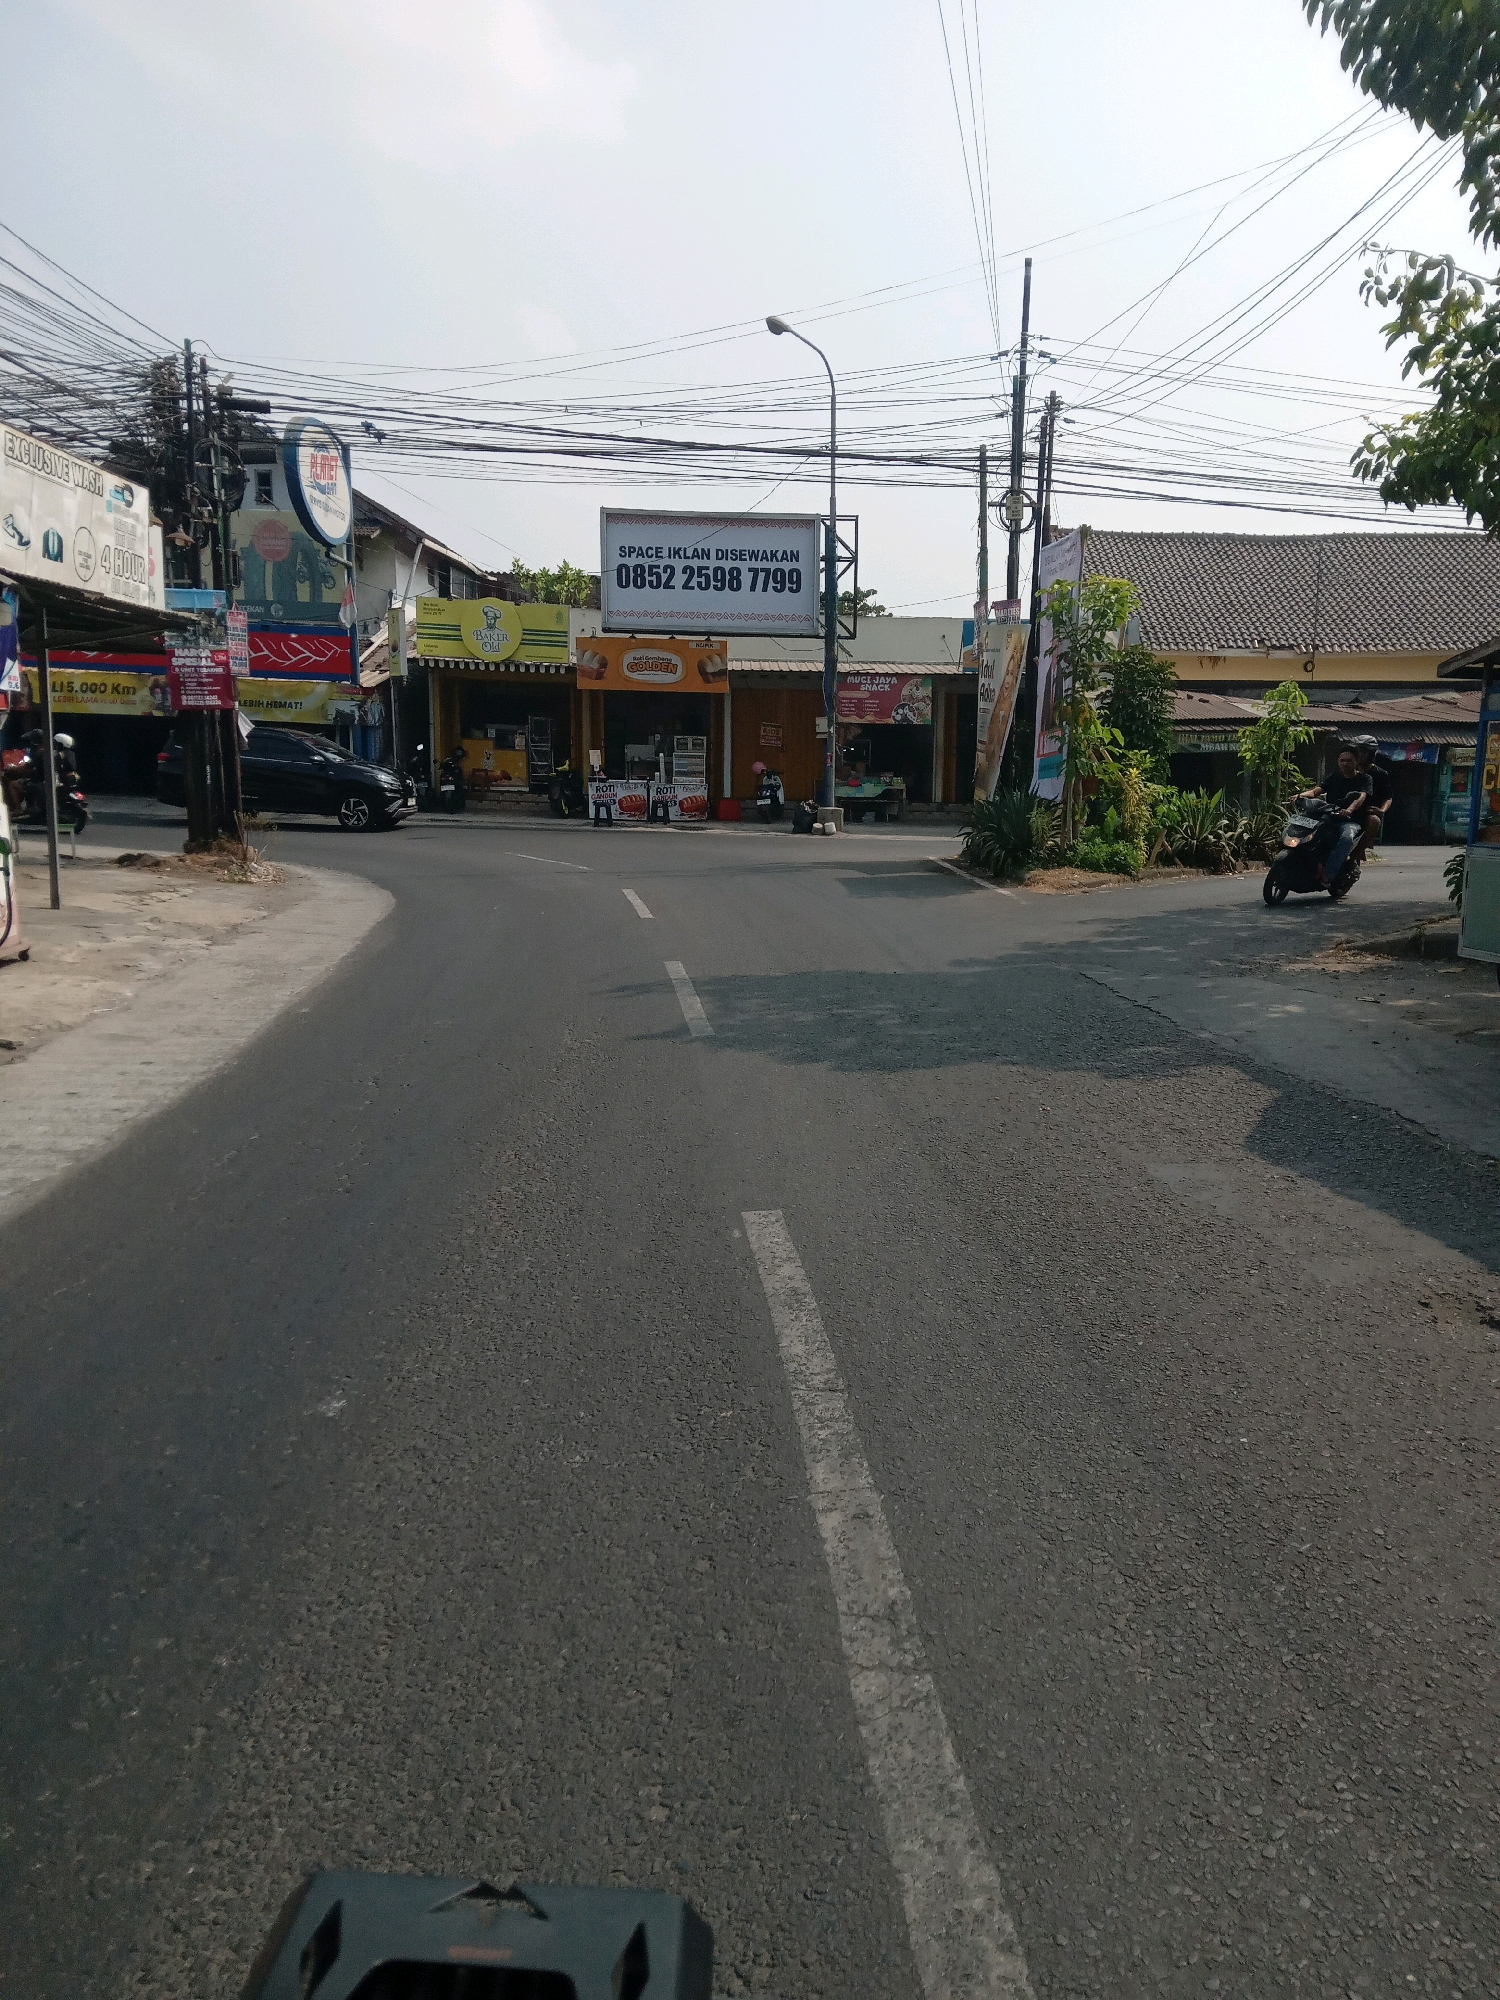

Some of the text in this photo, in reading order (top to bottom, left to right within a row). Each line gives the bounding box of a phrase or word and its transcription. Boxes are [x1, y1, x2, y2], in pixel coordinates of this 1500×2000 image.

[4, 430, 104, 497] EXCLUSIVE WASH
[310, 452, 339, 481] PLANET
[618, 545, 800, 563] SPACE IKLAN DISEWAKAN
[101, 545, 111, 574] 4
[113, 547, 146, 584] HOUR
[616, 563, 802, 593] 0852 2598 7799
[472, 629, 510, 642] BAKER
[174, 648, 212, 657] HARGA
[481, 641, 501, 653] Old
[171, 657, 216, 666] SPESIAL
[627, 661, 679, 674] GOLDEN
[873, 676, 898, 684] JAYA
[66, 681, 108, 695] 5.000
[109, 682, 138, 696] Km
[238, 699, 303, 710] LEBIH HEMAT!
[595, 784, 615, 794] ROTI
[655, 786, 676, 796] ROTI
[591, 792, 618, 800] GANDUM
